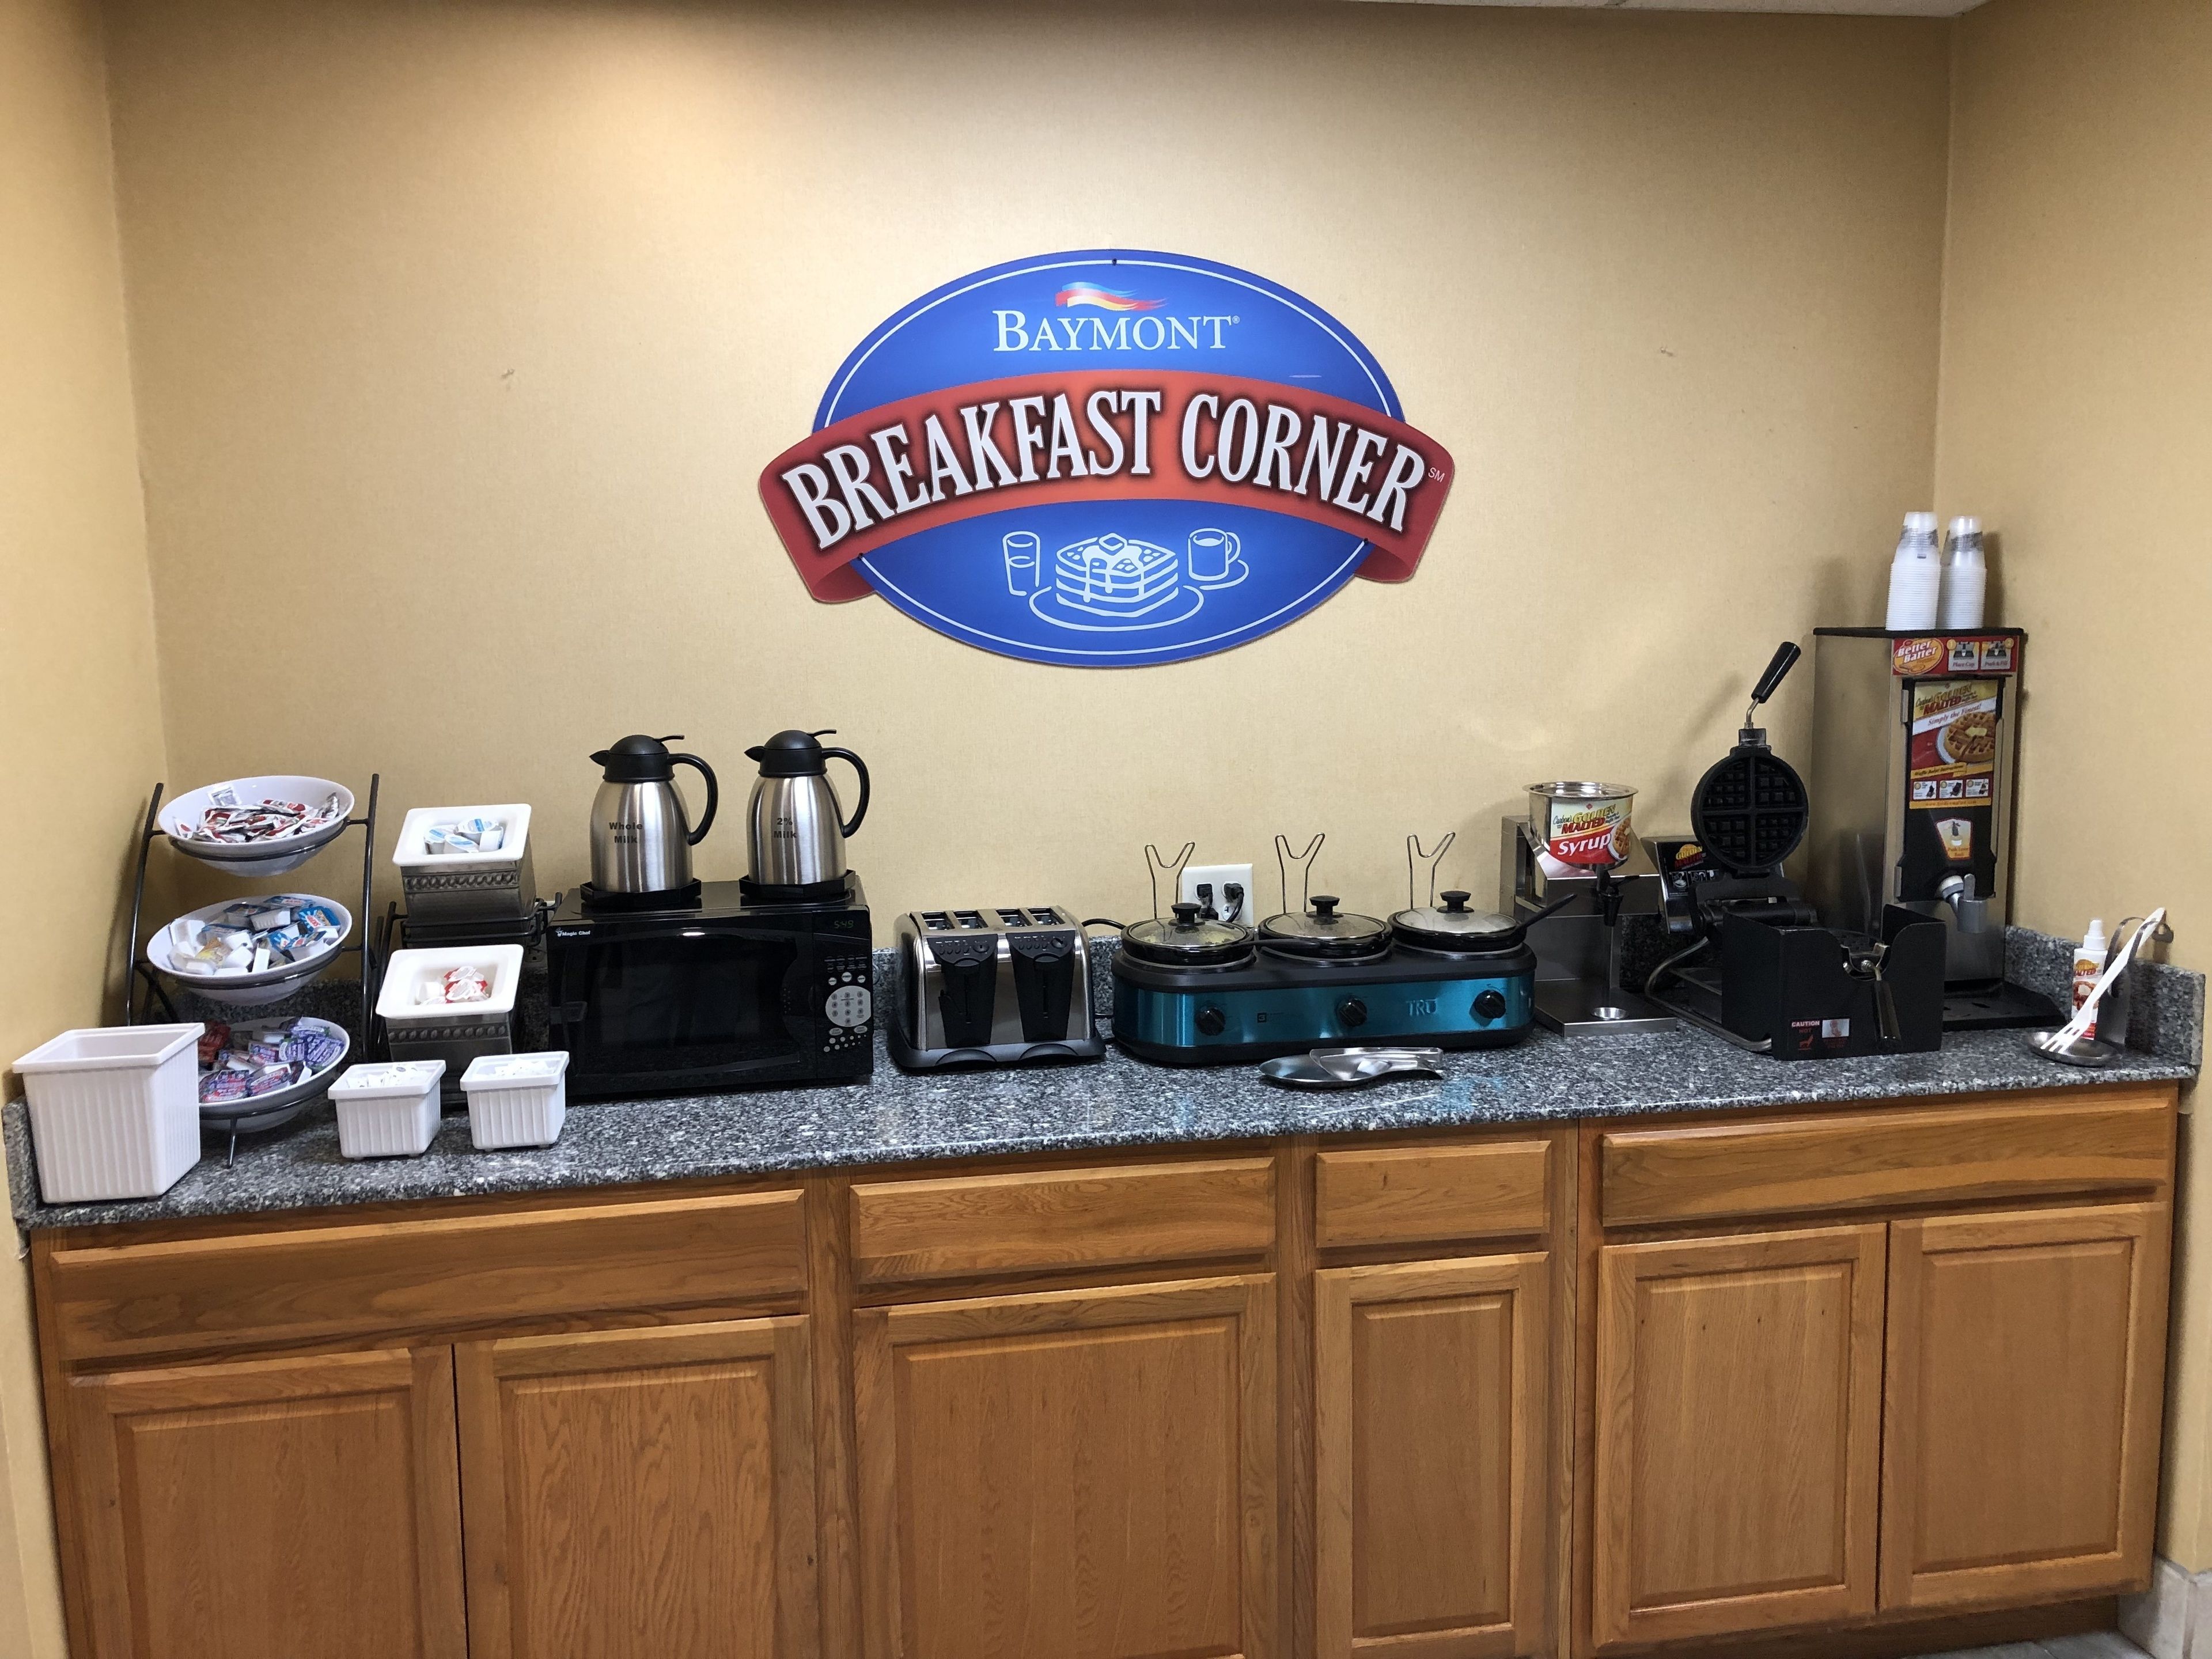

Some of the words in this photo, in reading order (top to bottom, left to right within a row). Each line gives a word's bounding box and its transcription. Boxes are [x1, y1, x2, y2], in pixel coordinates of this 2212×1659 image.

[781, 389, 1161, 550] BREAKFAST
[1181, 393, 1426, 533] CORNER
[1428, 467, 1445, 483] SM
[1897, 641, 1931, 657] Better
[1903, 646, 1937, 664] Batter
[1923, 695, 1961, 715] MALTED
[1928, 714, 1949, 725] Simply
[1950, 710, 1961, 718] the
[1961, 703, 1982, 715] Finest!
[777, 817, 793, 825] 2%
[1572, 804, 1616, 824] GOLDEN
[609, 822, 643, 830] Whole
[1561, 817, 1605, 834] MALTED
[614, 835, 638, 843] Milk
[1557, 833, 1611, 857] Syrup
[834, 919, 854, 929] 5:49
